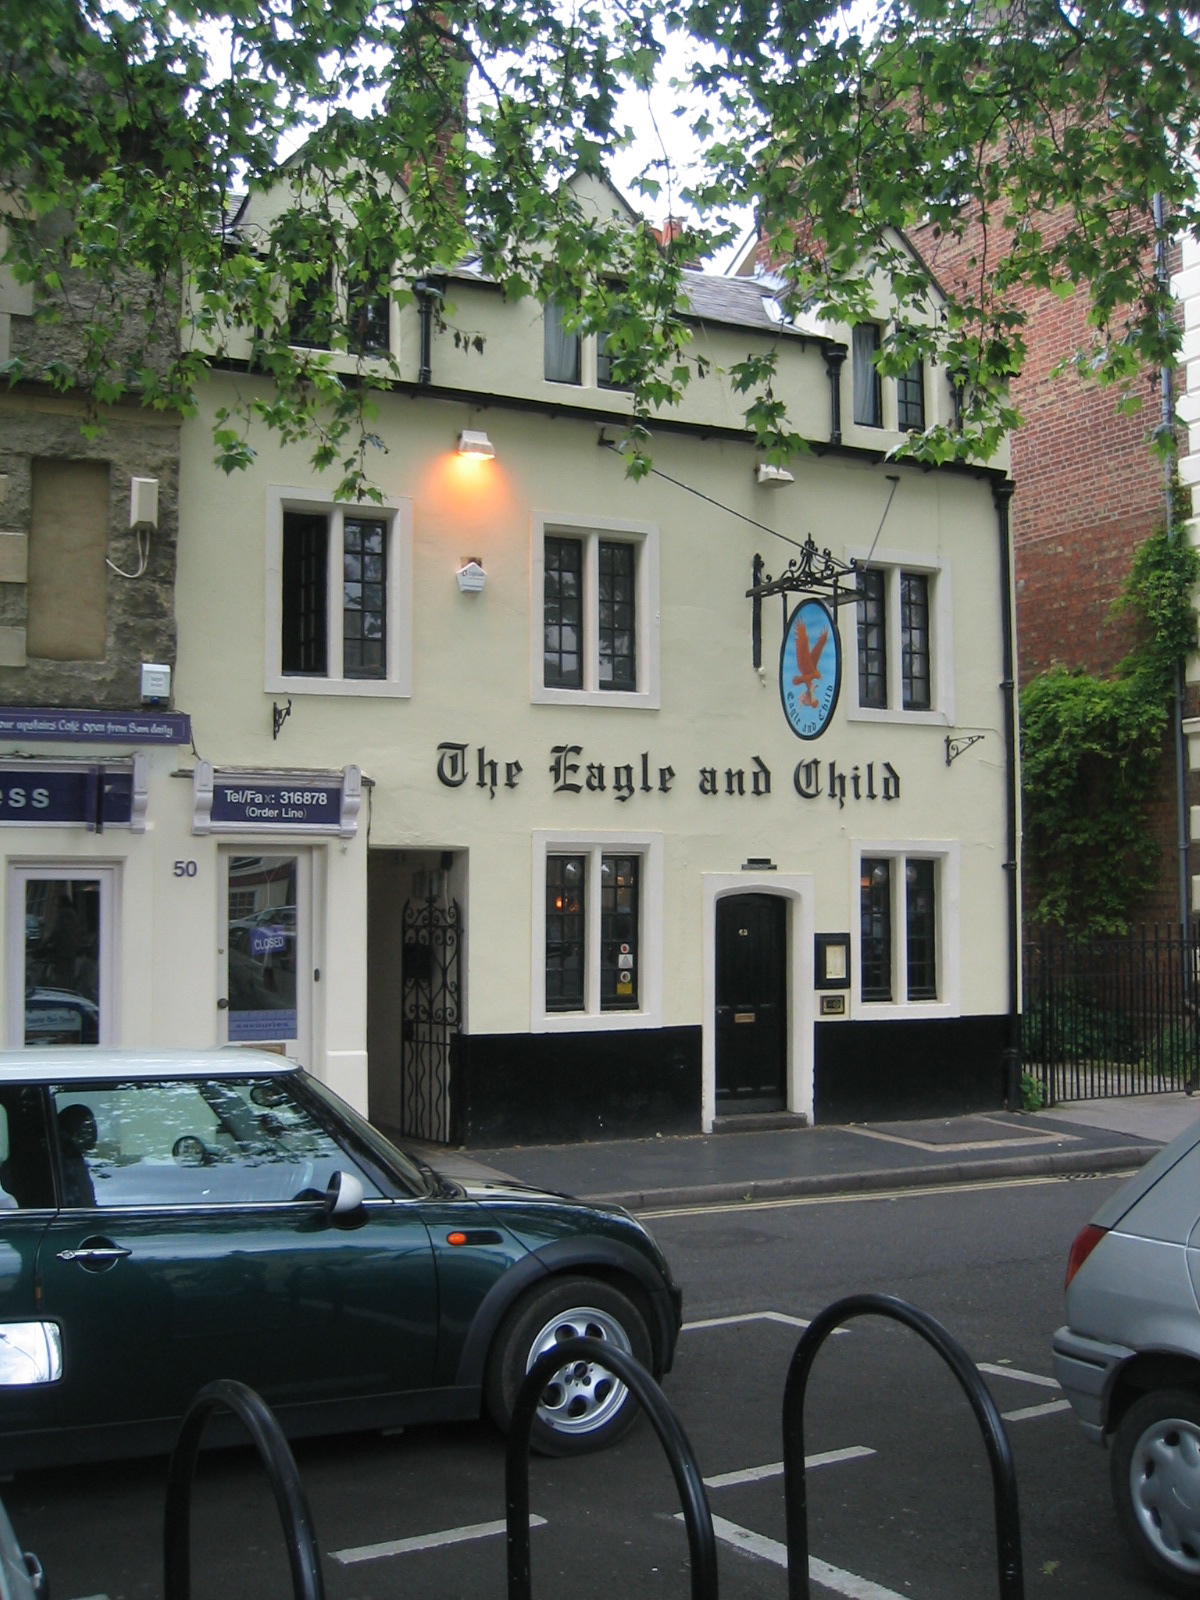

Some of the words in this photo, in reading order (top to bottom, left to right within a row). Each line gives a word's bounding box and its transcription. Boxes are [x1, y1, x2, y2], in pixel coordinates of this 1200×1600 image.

[16, 719, 57, 732] upstairs
[82, 722, 105, 733] open
[106, 722, 127, 734] from
[150, 723, 173, 738] daily
[436, 742, 524, 800] The
[549, 744, 676, 802] Eagle
[698, 755, 771, 796] and
[793, 757, 901, 809] Child
[0, 787, 50, 809] ss
[280, 791, 328, 805] 316878
[245, 806, 279, 818] (Order
[174, 860, 198, 877] 50
[254, 936, 284, 950] CLOSED
[235, 1022, 289, 1030] savouries
